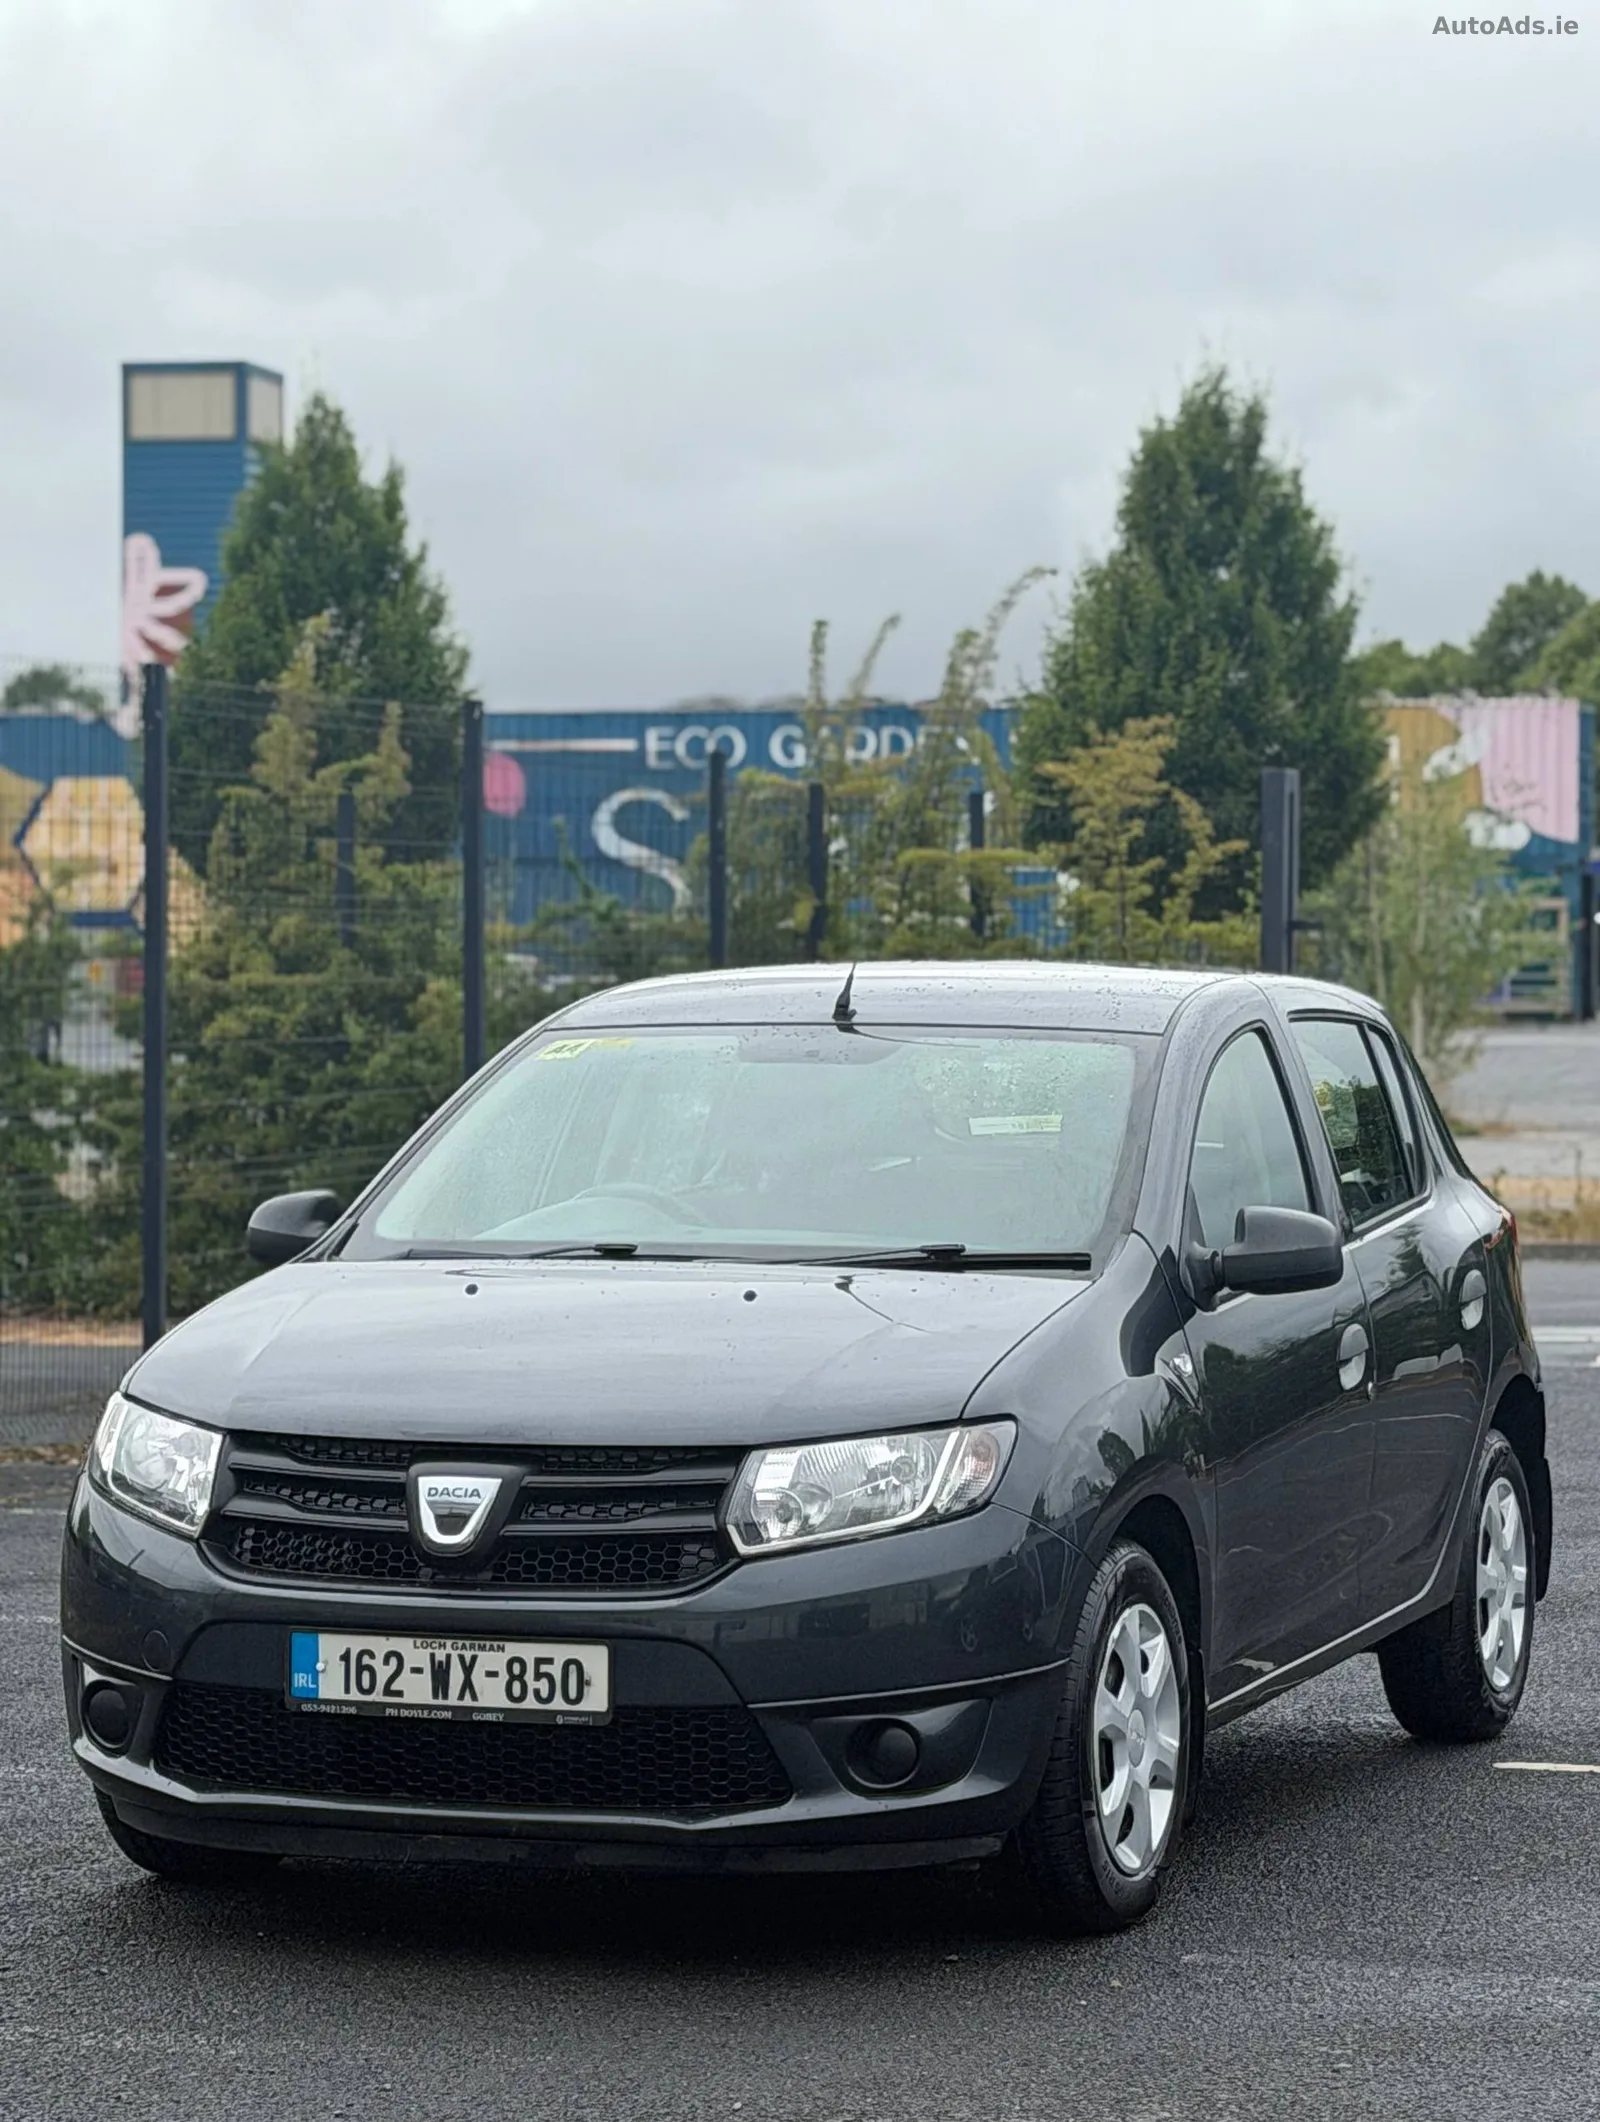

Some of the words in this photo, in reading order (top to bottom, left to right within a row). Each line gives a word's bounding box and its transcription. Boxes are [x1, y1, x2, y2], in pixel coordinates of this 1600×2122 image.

[645, 725, 747, 770] ECO
[427, 1486, 482, 1499] DACIA
[413, 1639, 447, 1651] LOCH
[450, 1641, 505, 1653] GARMAN
[294, 1673, 317, 1688] IRL
[338, 1647, 585, 1706] 162-WX-850
